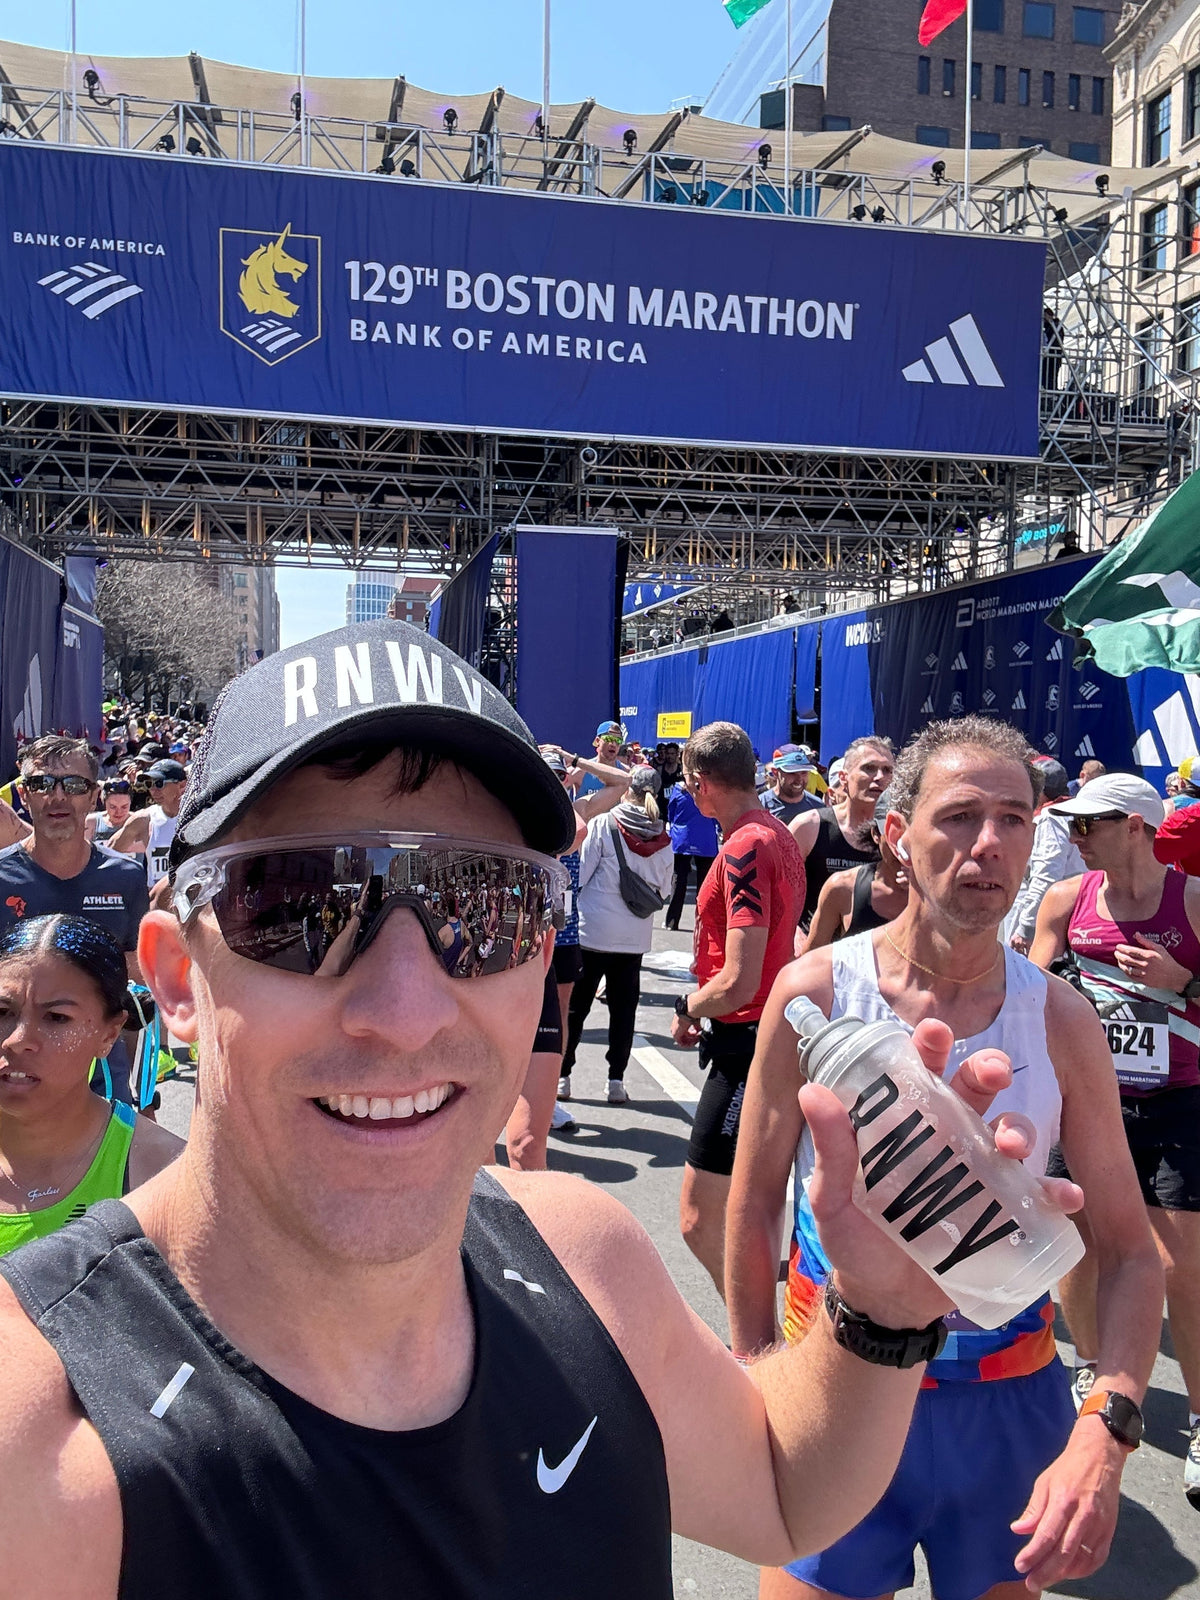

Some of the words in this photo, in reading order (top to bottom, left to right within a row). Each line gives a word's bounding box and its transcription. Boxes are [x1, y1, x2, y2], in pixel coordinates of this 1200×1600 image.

[13, 231, 61, 247] BANK
[64, 236, 86, 249] OF
[90, 238, 166, 256] AMERICA
[446, 269, 615, 323] BOSTON
[628, 286, 855, 340] MARATHON
[350, 319, 443, 348] BANK
[452, 328, 493, 351] OF
[502, 333, 648, 364] AMERICA
[976, 609, 996, 620] WORLD
[997, 602, 1037, 617] MARATHON
[284, 641, 482, 727] RNWY
[83, 896, 124, 905] ATHLETE
[1101, 1023, 1156, 1057] 624
[849, 1072, 1020, 1276] RNWY
